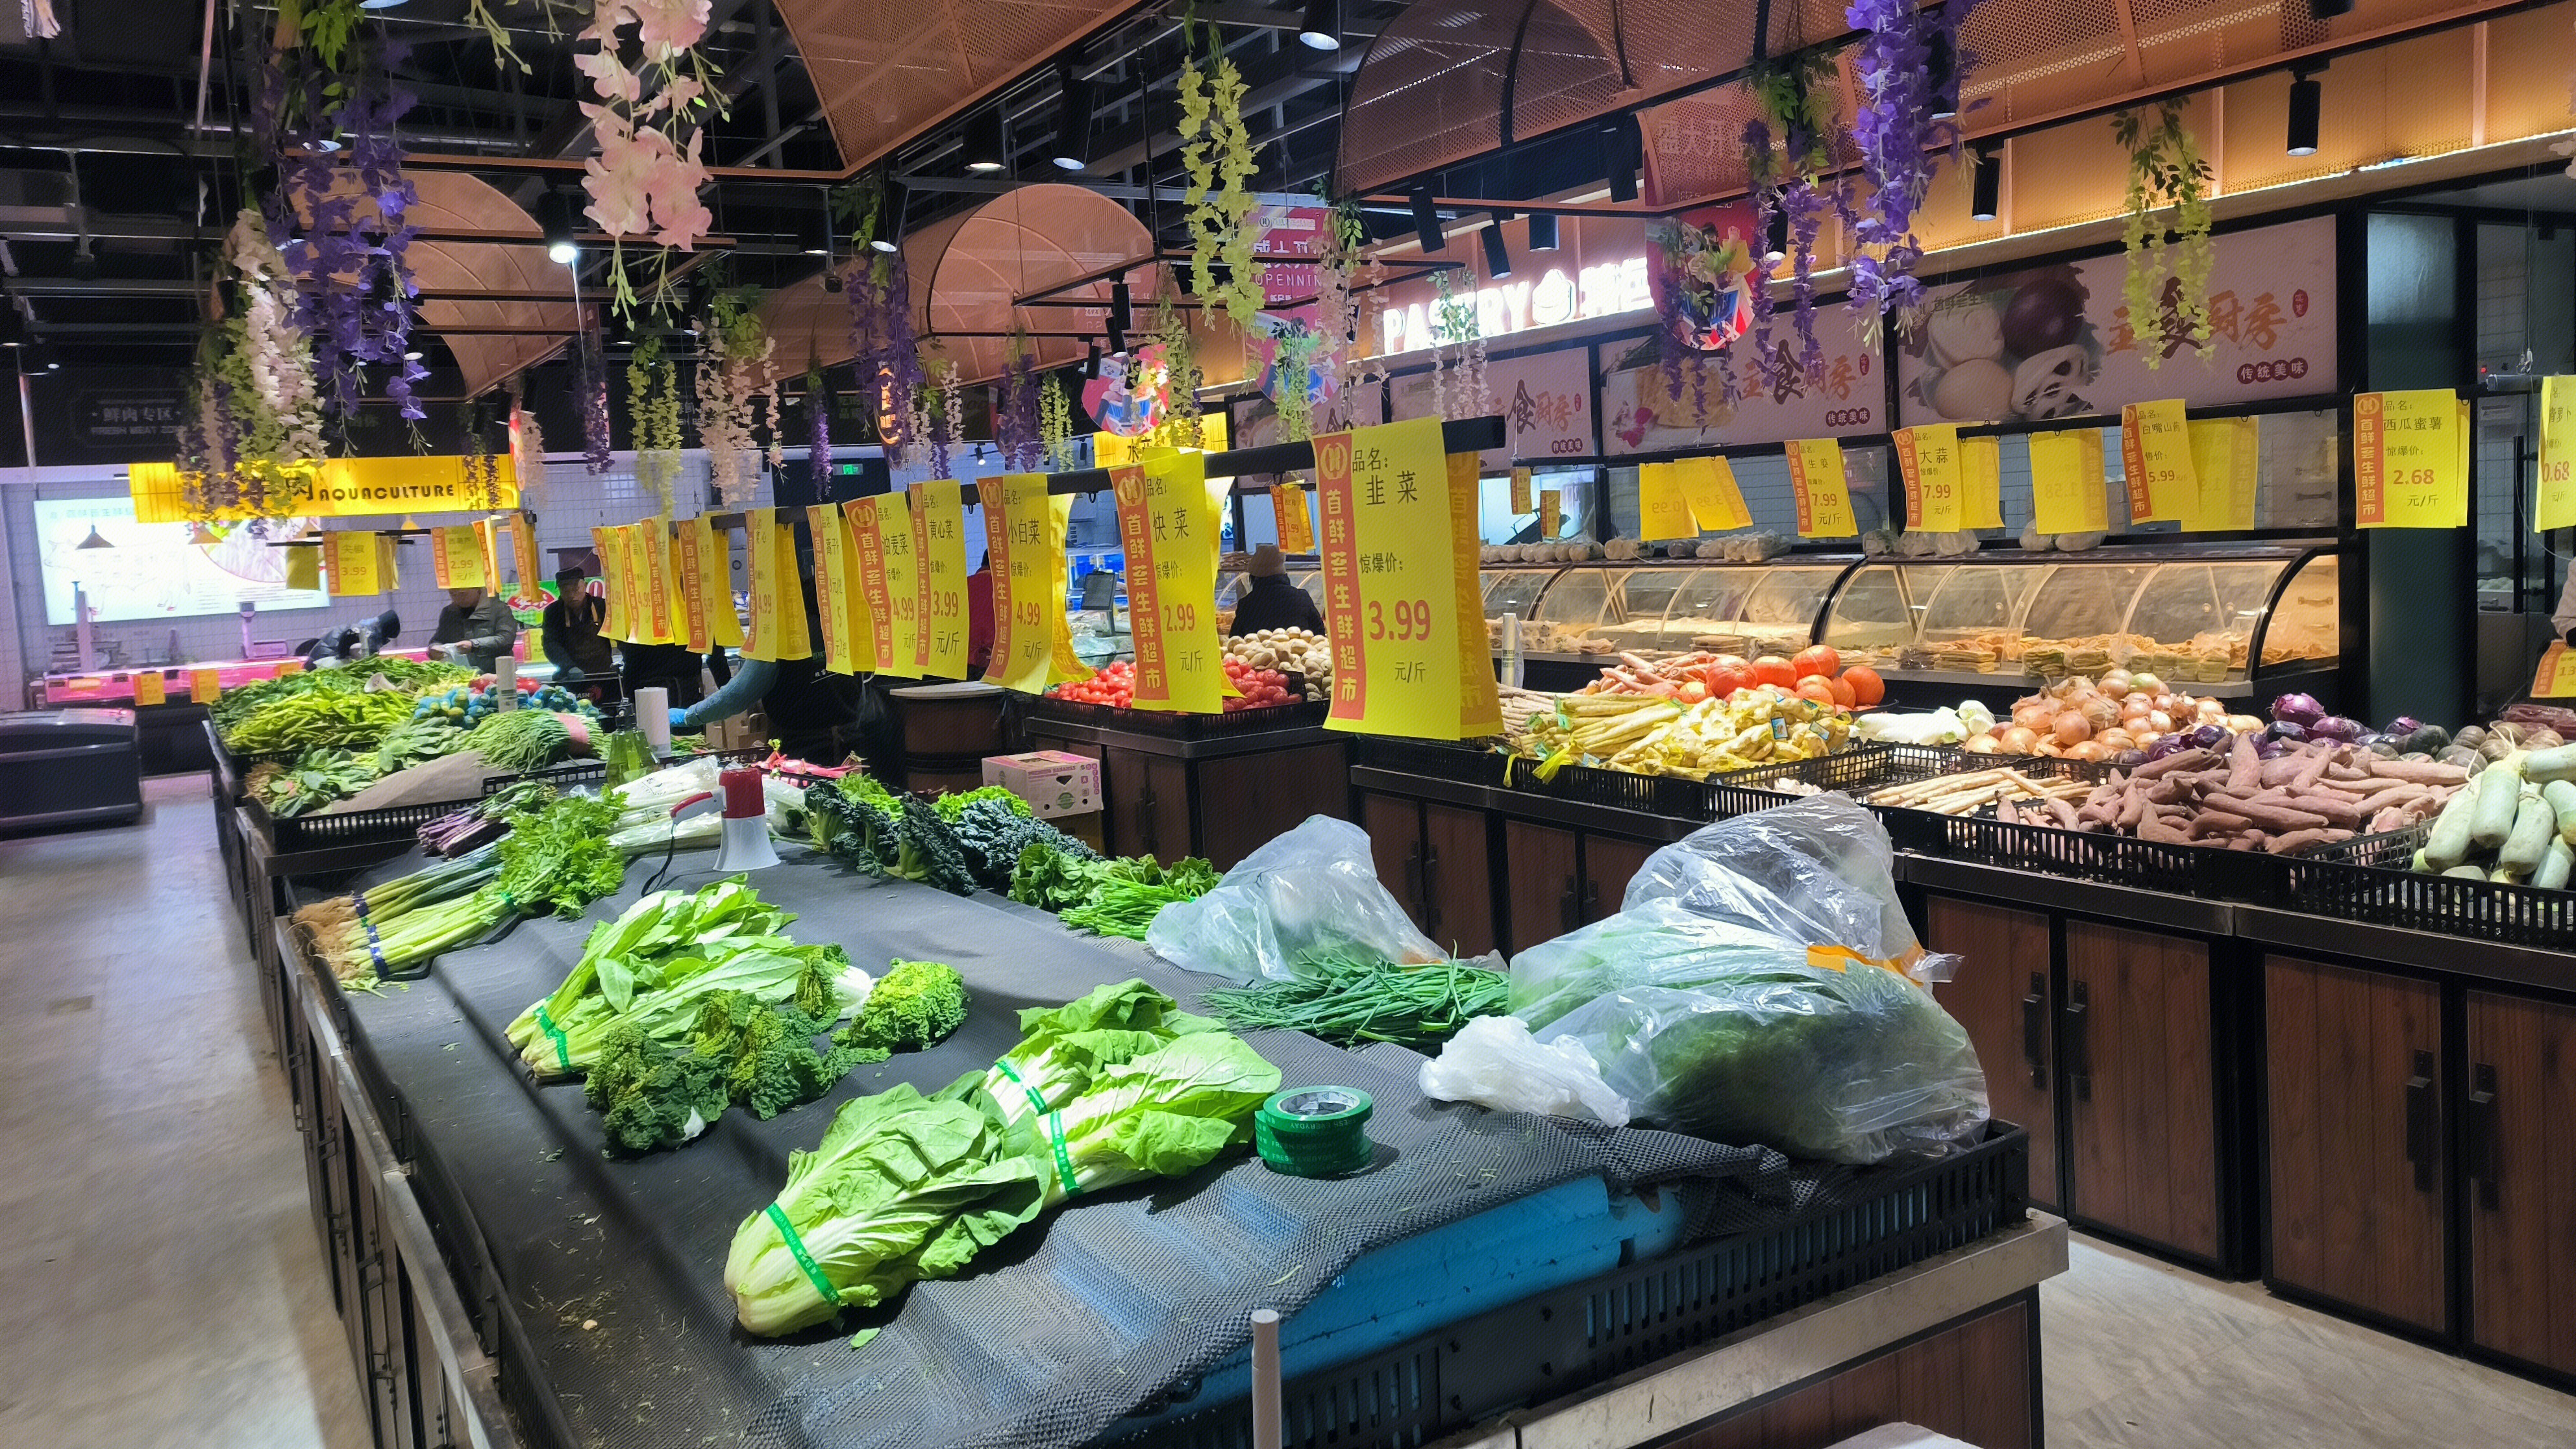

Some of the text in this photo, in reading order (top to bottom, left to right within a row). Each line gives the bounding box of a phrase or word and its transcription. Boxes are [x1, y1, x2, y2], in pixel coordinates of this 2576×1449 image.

[1255, 273, 1322, 287] OPENNIN
[2240, 361, 2305, 380] 传统美味
[2138, 409, 2161, 421] 品名：
[2383, 400, 2413, 412] 品名：
[1827, 410, 1869, 426] 传统美味
[2383, 416, 2442, 431] 西瓜蜜薯
[1352, 447, 1389, 473] 品名：
[1918, 447, 1948, 465] 大蒜
[2386, 445, 2423, 457] 惊爆价：
[1808, 458, 1828, 468] 生姜
[2123, 427, 2146, 512] 首鲜荟生鲜超市
[2360, 418, 2376, 515] 首鲜荟生鲜超市
[2542, 460, 2570, 482] 0.68
[1146, 477, 1167, 497] 品名：
[1901, 447, 1918, 522] 首鲜荟生鲜超市
[2148, 469, 2175, 483] 5.99
[2392, 469, 2434, 485] 2.68
[1004, 489, 1021, 505] 品名：
[1365, 469, 1418, 506] 韭菜
[1924, 484, 1951, 499] 7.99
[1811, 493, 1837, 506] 7.99
[1934, 506, 1951, 515] 元/斤
[2407, 495, 2439, 507] 元/斤
[928, 519, 953, 539] 黄心菜
[1152, 507, 1189, 543] 快菜
[1818, 513, 1842, 525] 元/斤
[1008, 517, 1041, 545] 小白菜
[881, 532, 909, 556] 油麦菜
[341, 566, 367, 576] 3.99
[450, 560, 473, 569] 2.99
[1359, 552, 1404, 575] 惊爆价：
[684, 544, 704, 641] 首鲜荟生鲜超市
[860, 532, 889, 660] 首鲜荟生鲜超市
[915, 517, 928, 655] 首鲜荟生鲜超市
[989, 515, 1008, 666] 首鲜荟生鲜超市
[1326, 488, 1357, 702] 首鲜荟生鲜超市
[758, 593, 773, 615] 4.99
[893, 596, 915, 621] 4.99
[933, 589, 959, 618] 3.99
[1126, 514, 1161, 689] 首鲜荟生鲜超市
[1017, 601, 1041, 627] 4.99
[1164, 603, 1195, 632] 2.99
[1368, 599, 1431, 641] 3.99
[935, 630, 960, 656] 元/斤
[1022, 639, 1042, 660] 元/斤
[1180, 650, 1202, 673] 元/斤
[1394, 661, 1426, 684] 元/斤
[1272, 1141, 1293, 1150] FRESH
[1272, 1153, 1294, 1162] FRESH
